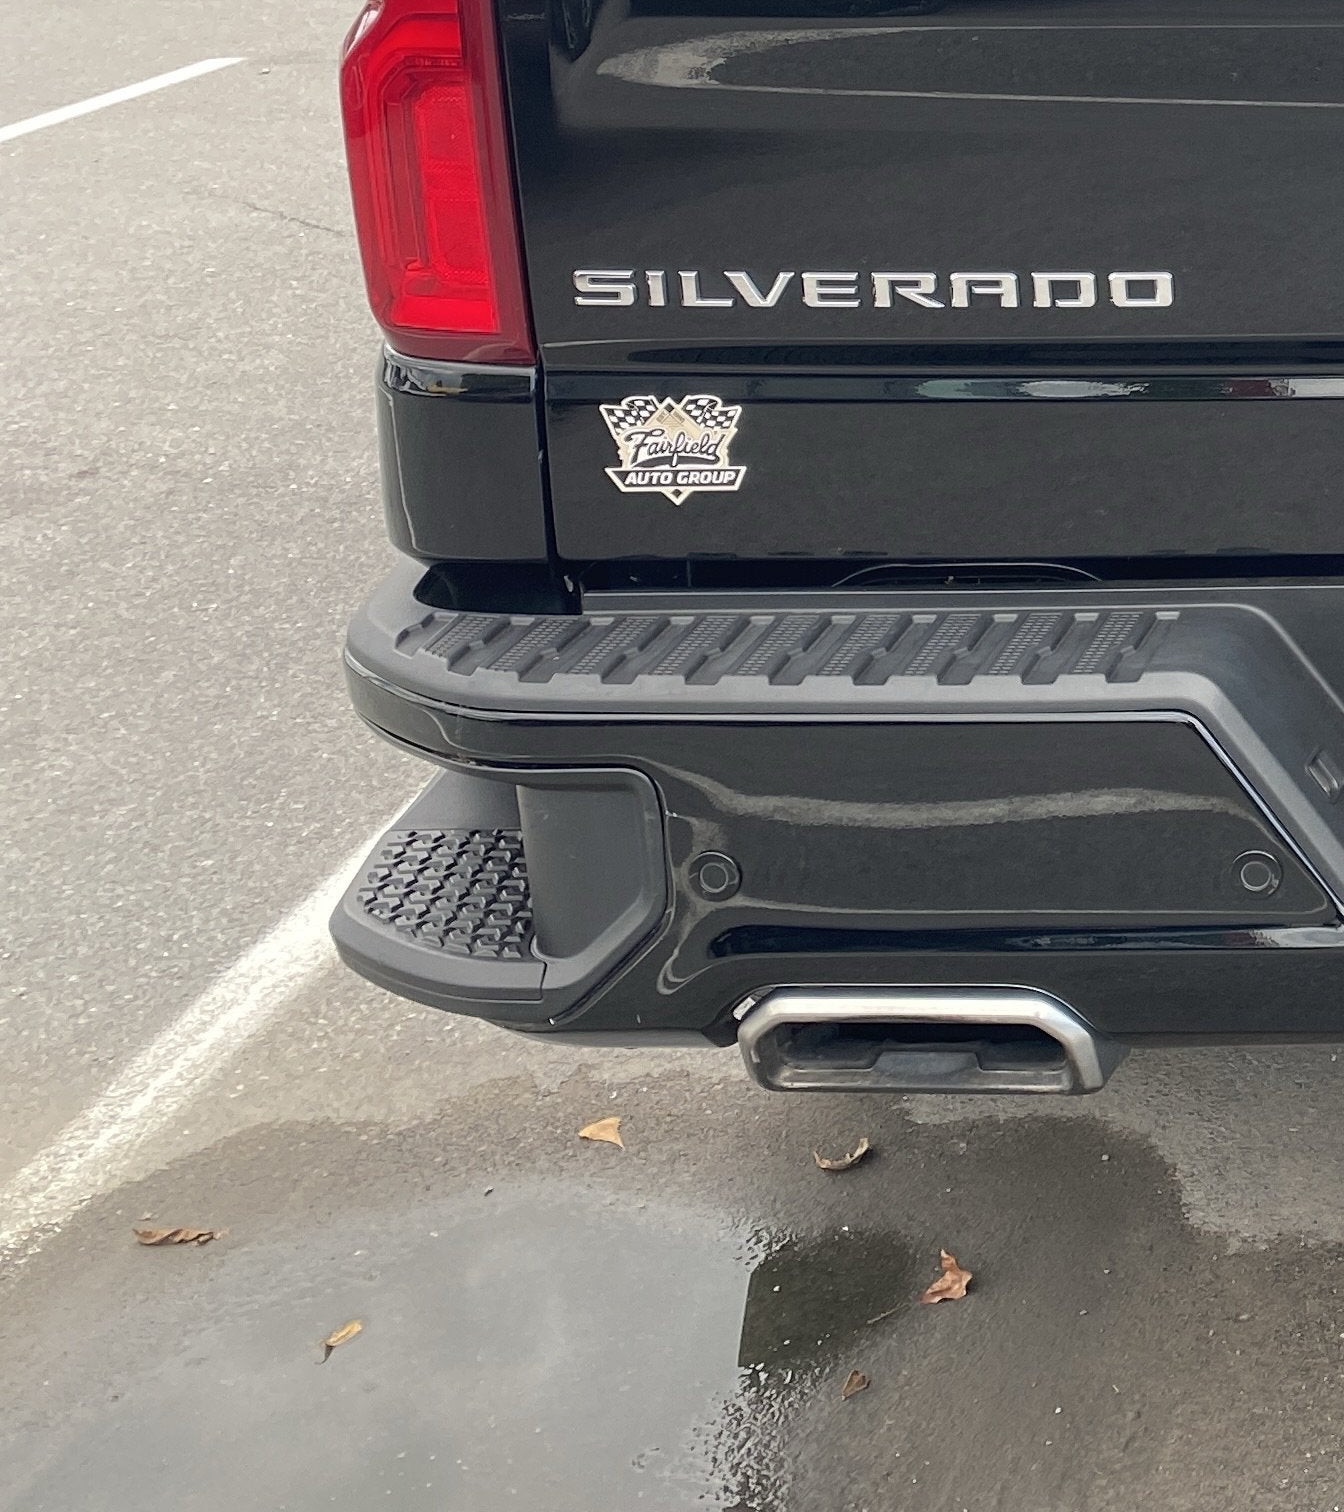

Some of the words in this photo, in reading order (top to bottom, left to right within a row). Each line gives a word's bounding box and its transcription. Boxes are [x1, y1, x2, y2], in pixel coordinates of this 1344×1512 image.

[573, 268, 1177, 309] SILVERADO
[624, 428, 726, 468] Fairfield
[624, 472, 673, 485] AUTO
[676, 471, 736, 485] GROUP
